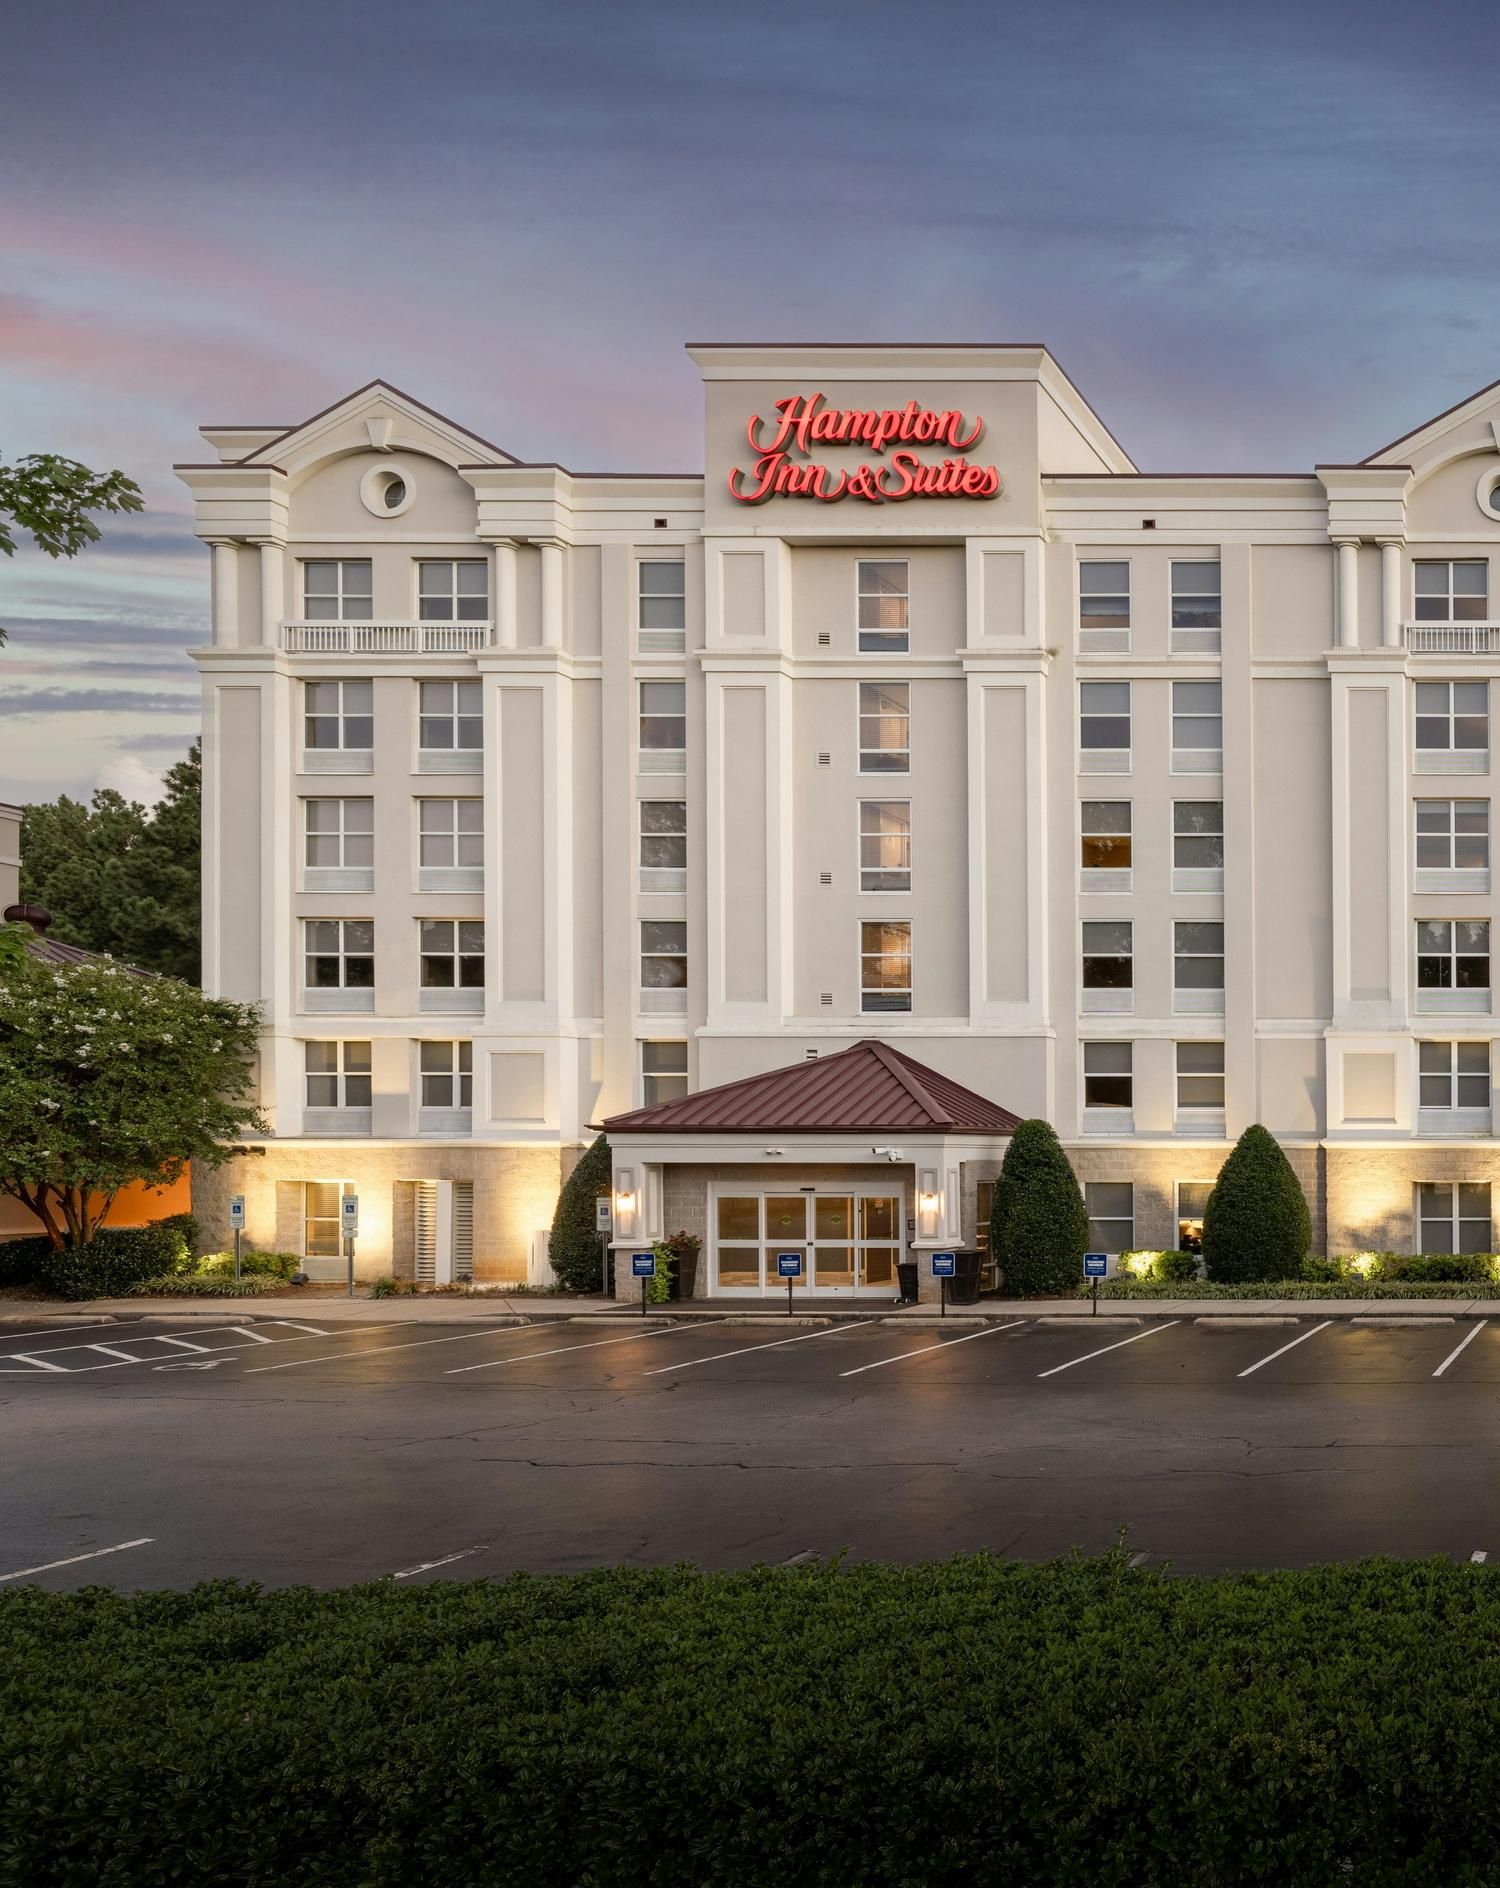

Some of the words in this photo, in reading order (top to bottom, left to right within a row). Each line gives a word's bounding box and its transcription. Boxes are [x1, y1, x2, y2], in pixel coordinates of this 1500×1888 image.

[748, 392, 983, 452] Hampton
[729, 453, 846, 500] Inn
[848, 464, 879, 500] &
[875, 451, 999, 498] Suites
